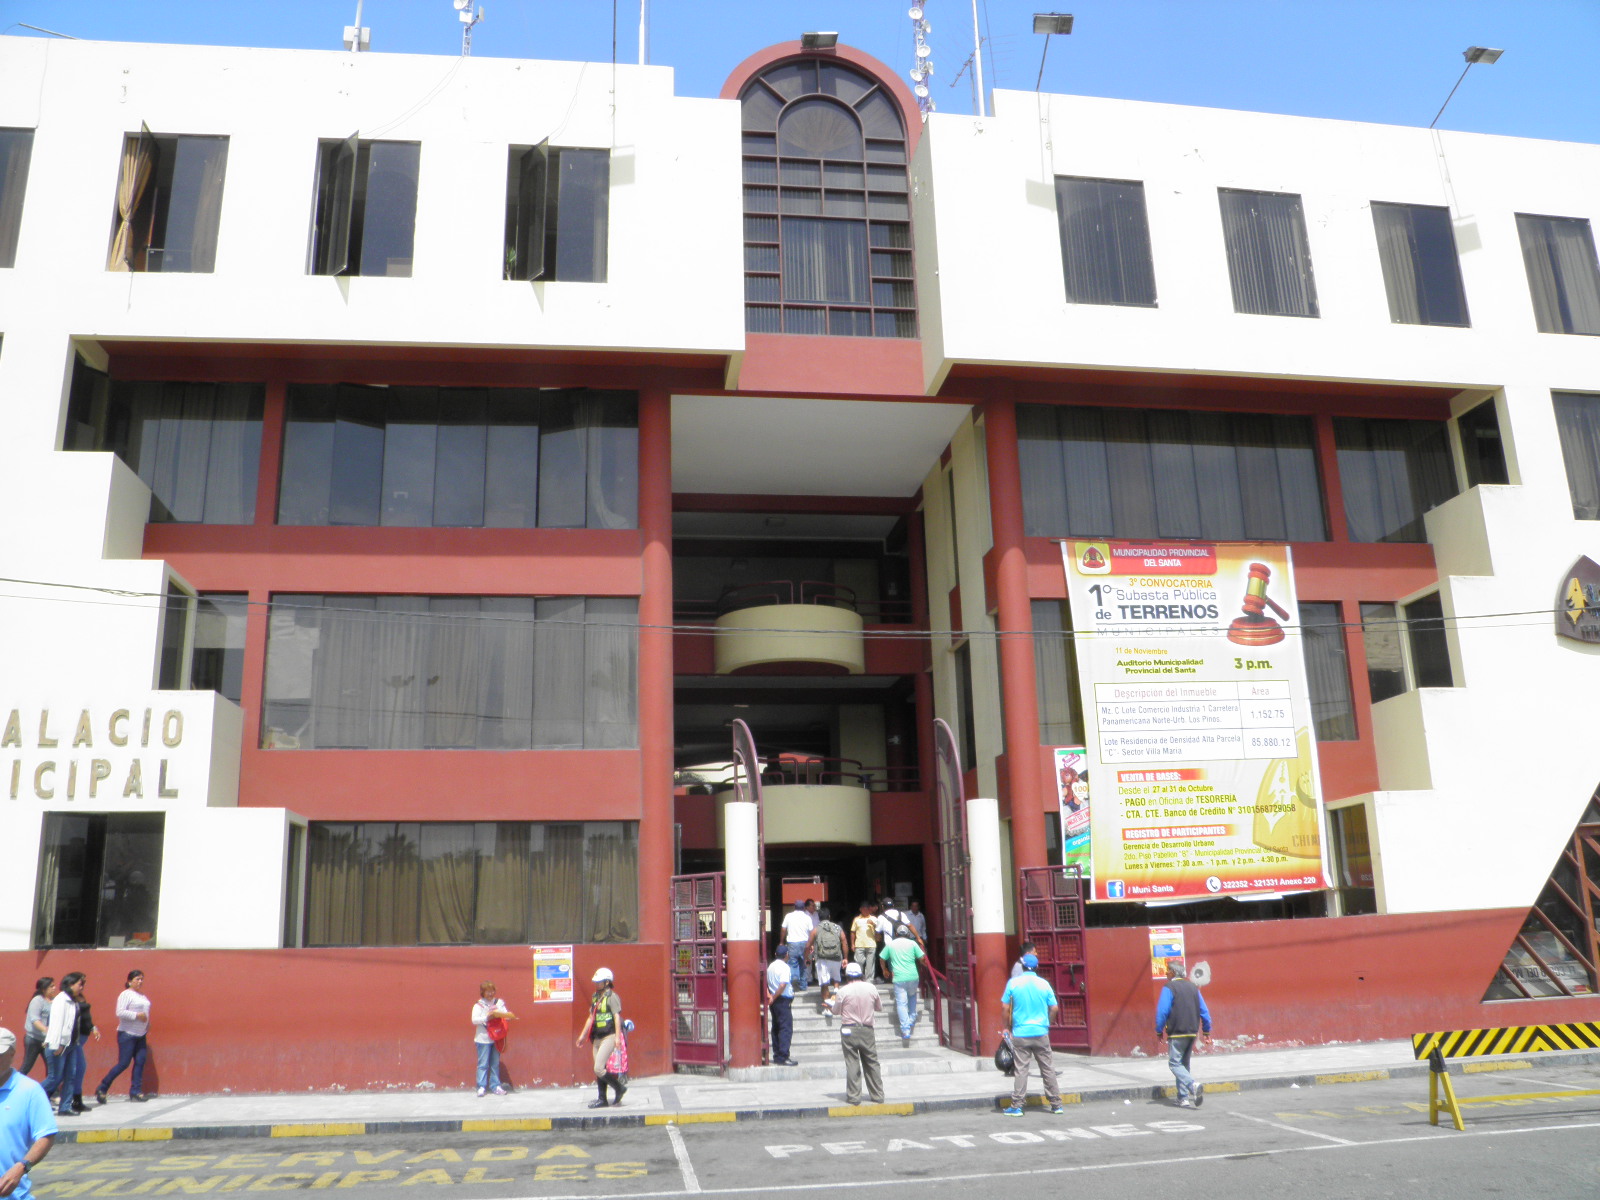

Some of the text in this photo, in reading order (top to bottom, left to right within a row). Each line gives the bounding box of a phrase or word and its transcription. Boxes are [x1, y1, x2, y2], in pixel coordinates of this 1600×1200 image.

[1113, 548, 1210, 557] MUNICIPALIDAD PROVINCIAL
[1144, 559, 1182, 567] DEL SANTA
[1140, 578, 1213, 588] CONVOCATORIA
[1117, 590, 1169, 600] Subasta
[1174, 588, 1217, 600] Pública
[1096, 604, 1219, 620] de TERRENOS
[1097, 627, 1220, 636] MUNICIPALES
[1154, 659, 1204, 667] Municipalidad
[1234, 658, 1272, 670] 3 p.m.
[1166, 688, 1178, 697] del
[1180, 688, 1217, 697] Inmueble
[1102, 706, 1113, 714] Mz.
[1114, 706, 1120, 714] C
[1122, 706, 1136, 714] Lote
[1139, 706, 1170, 714] Comercio
[1172, 704, 1200, 712] Industria
[1208, 704, 1239, 712] Carretera
[1250, 710, 1285, 719] 1.152.75
[1102, 717, 1150, 726] Panamericana
[1188, 716, 1200, 724] Los
[1, 708, 184, 748] ALACIO
[1104, 738, 1119, 746] Lote
[1120, 737, 1158, 745] Residencia
[1160, 736, 1168, 744] de
[1170, 736, 1200, 744] Densidad
[1216, 734, 1241, 742] Parcela
[1122, 748, 1144, 756] Sector
[1146, 748, 1160, 756] Villa
[10, 758, 179, 800] ICIPAL
[1120, 772, 1182, 782] VENTA DE BASES:
[1118, 786, 1142, 795] Desde
[1144, 786, 1150, 794] el
[1152, 786, 1160, 794] 27
[1170, 785, 1176, 793] 31
[1178, 784, 1186, 792] de
[1188, 784, 1214, 792] Octubre
[1125, 798, 1146, 806] PAGO
[1158, 796, 1184, 806] Oficina
[1186, 796, 1194, 804] de
[1126, 810, 1142, 819] CTA.
[1145, 809, 1162, 818] CTE.
[1164, 808, 1186, 817] Banco
[1188, 808, 1198, 816] de
[1125, 826, 1226, 839] REGISTRO DE PARTICIPANTES
[1138, 852, 1152, 860] Piso
[1194, 848, 1234, 858] Municipalidad
[1124, 862, 1143, 870] Lunes
[1176, 860, 1190, 868] 7:30
[1276, 856, 1288, 864] p.m.
[1223, 880, 1248, 888] 322352
[1254, 879, 1278, 887] 321331
[1280, 878, 1302, 886] Anexo
[1132, 886, 1150, 894] Muni
[1152, 884, 1174, 892] Santa
[764, 1120, 1206, 1158] PEATONES
[32, 1144, 592, 1175] RESERVADA
[28, 1161, 648, 1198] MUNICIPALES
